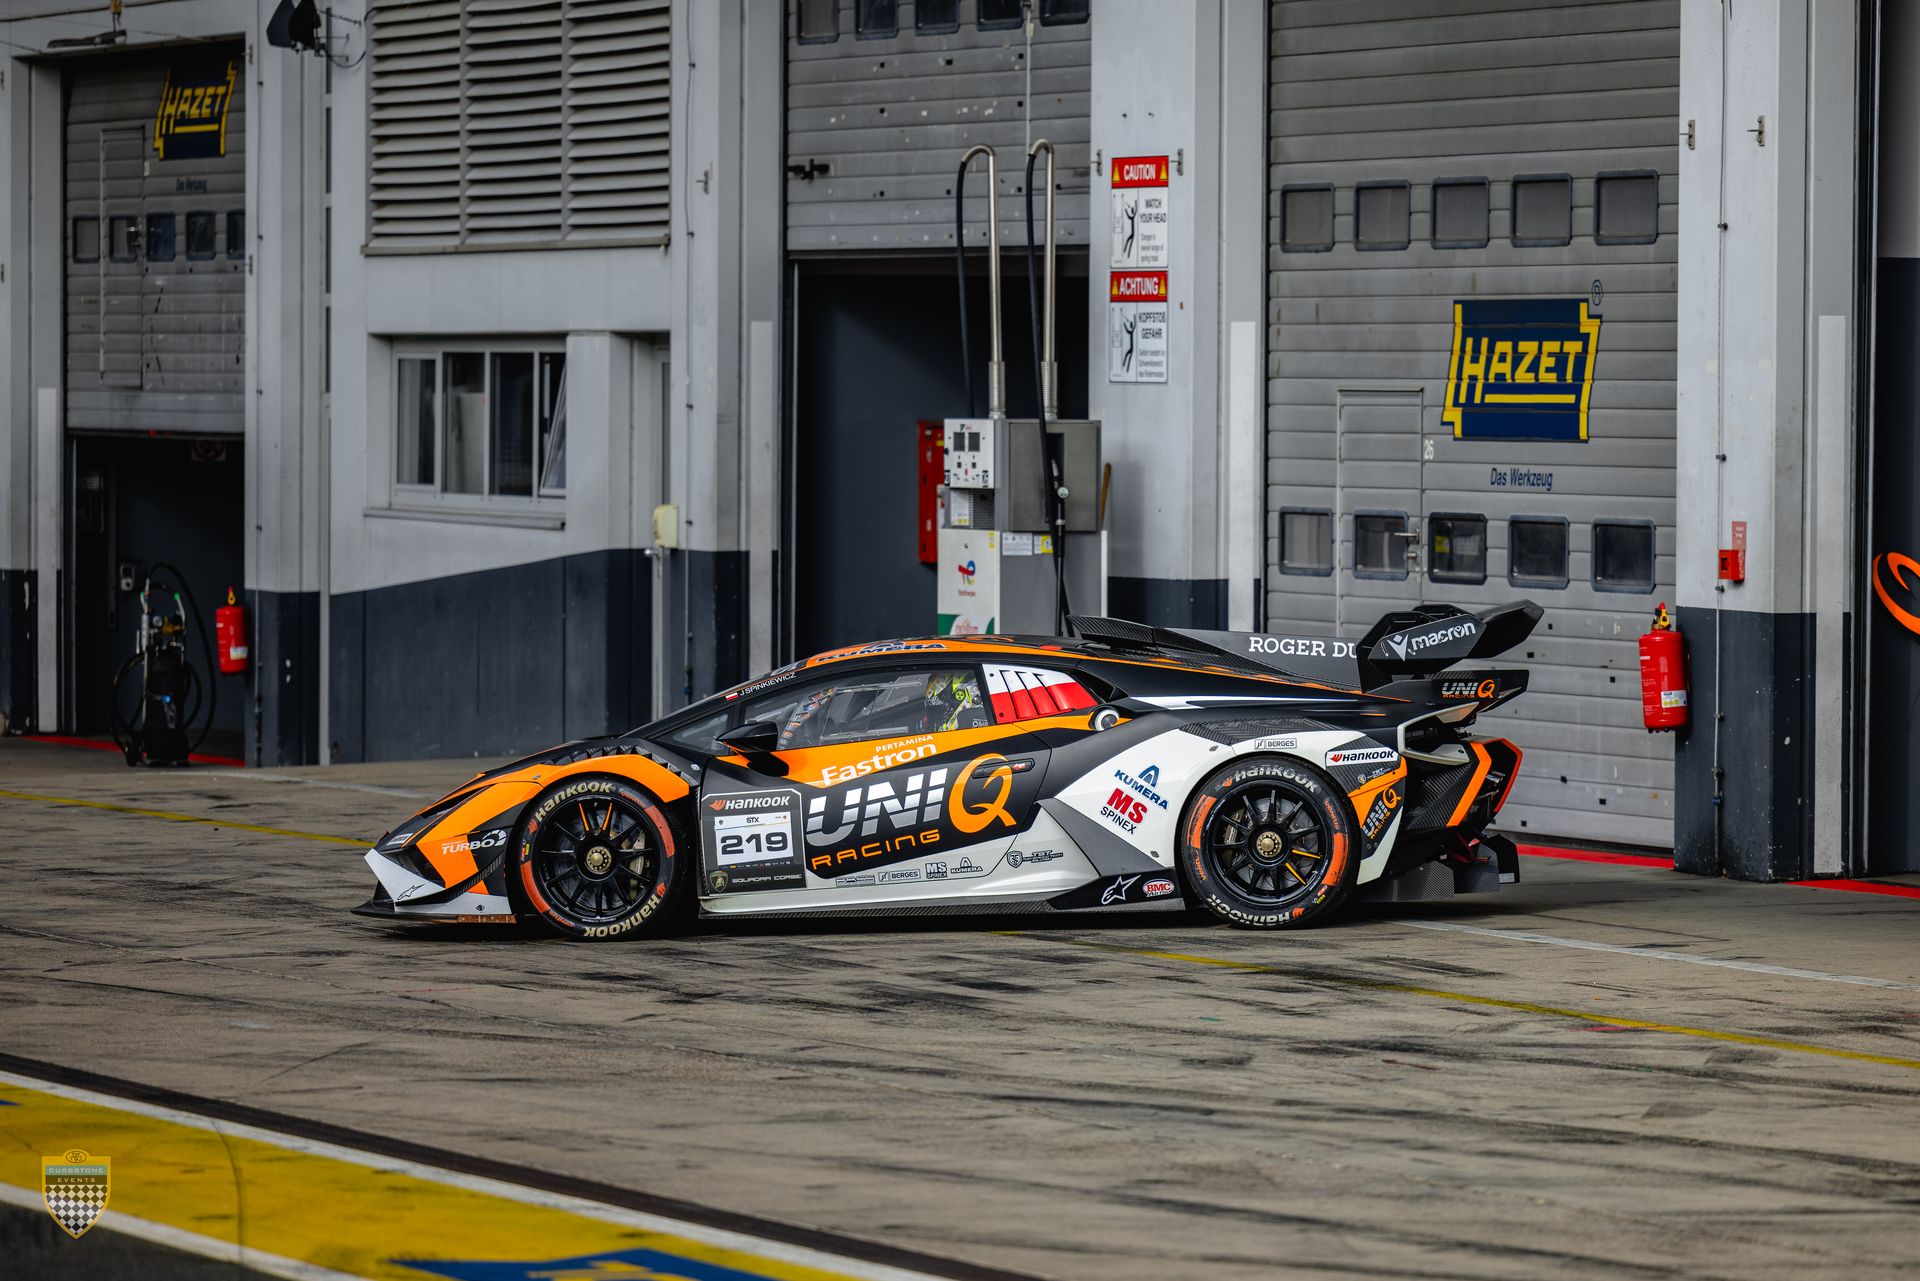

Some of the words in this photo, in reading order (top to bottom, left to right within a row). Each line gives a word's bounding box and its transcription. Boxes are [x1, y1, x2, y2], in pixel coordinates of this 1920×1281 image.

[162, 85, 227, 135] HAZET
[1123, 163, 1157, 181] CAUTION
[1145, 199, 1162, 208] WATCH
[1140, 213, 1153, 223] YOUR
[1153, 213, 1167, 223] HEAD
[1119, 277, 1159, 295] ACHTUNG
[1141, 328, 1163, 339] GEFAHR
[1458, 336, 1584, 404] HAZET
[1424, 440, 1434, 459] 26
[1490, 467, 1507, 486] Das
[1510, 468, 1553, 491] Werkzeug
[1411, 621, 1476, 652] macron
[1249, 636, 1326, 657] ROGER
[1441, 679, 1496, 699] UNIQ
[875, 734, 934, 752] PERTAMINA
[1267, 739, 1295, 748] BERGES
[821, 743, 937, 786] Fastron
[1113, 768, 1169, 811] KUMERA
[806, 753, 1018, 847] UNIQ
[1106, 787, 1148, 825] MS
[746, 816, 760, 824] STX
[1100, 806, 1138, 835] SPINEX
[720, 831, 788, 856] 219
[810, 829, 941, 870] RACING
[891, 871, 919, 879] BERGES
[926, 862, 947, 873] MS
[950, 865, 983, 874] KUMERA
[731, 875, 772, 884] SQUADRA
[773, 873, 803, 881] CORSE
[1146, 883, 1172, 893] BMC
